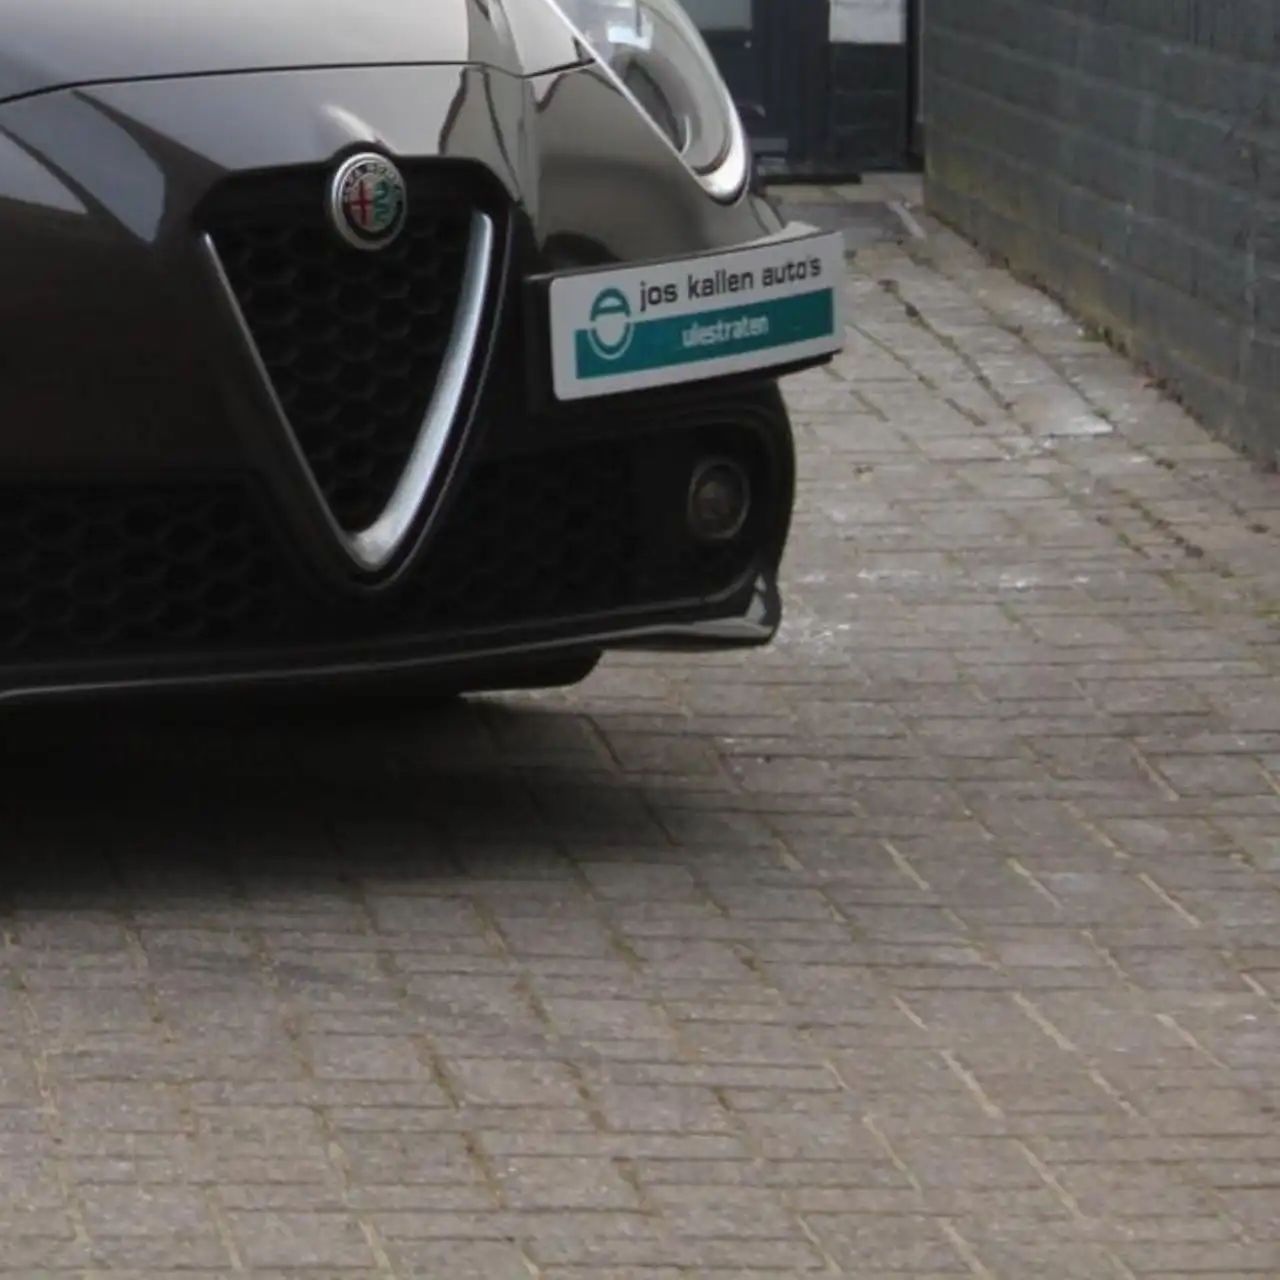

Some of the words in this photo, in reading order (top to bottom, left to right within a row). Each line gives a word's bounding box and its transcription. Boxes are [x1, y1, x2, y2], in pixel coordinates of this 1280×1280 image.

[640, 280, 678, 312] jos
[687, 268, 754, 300] kallen
[761, 255, 822, 287] auto's
